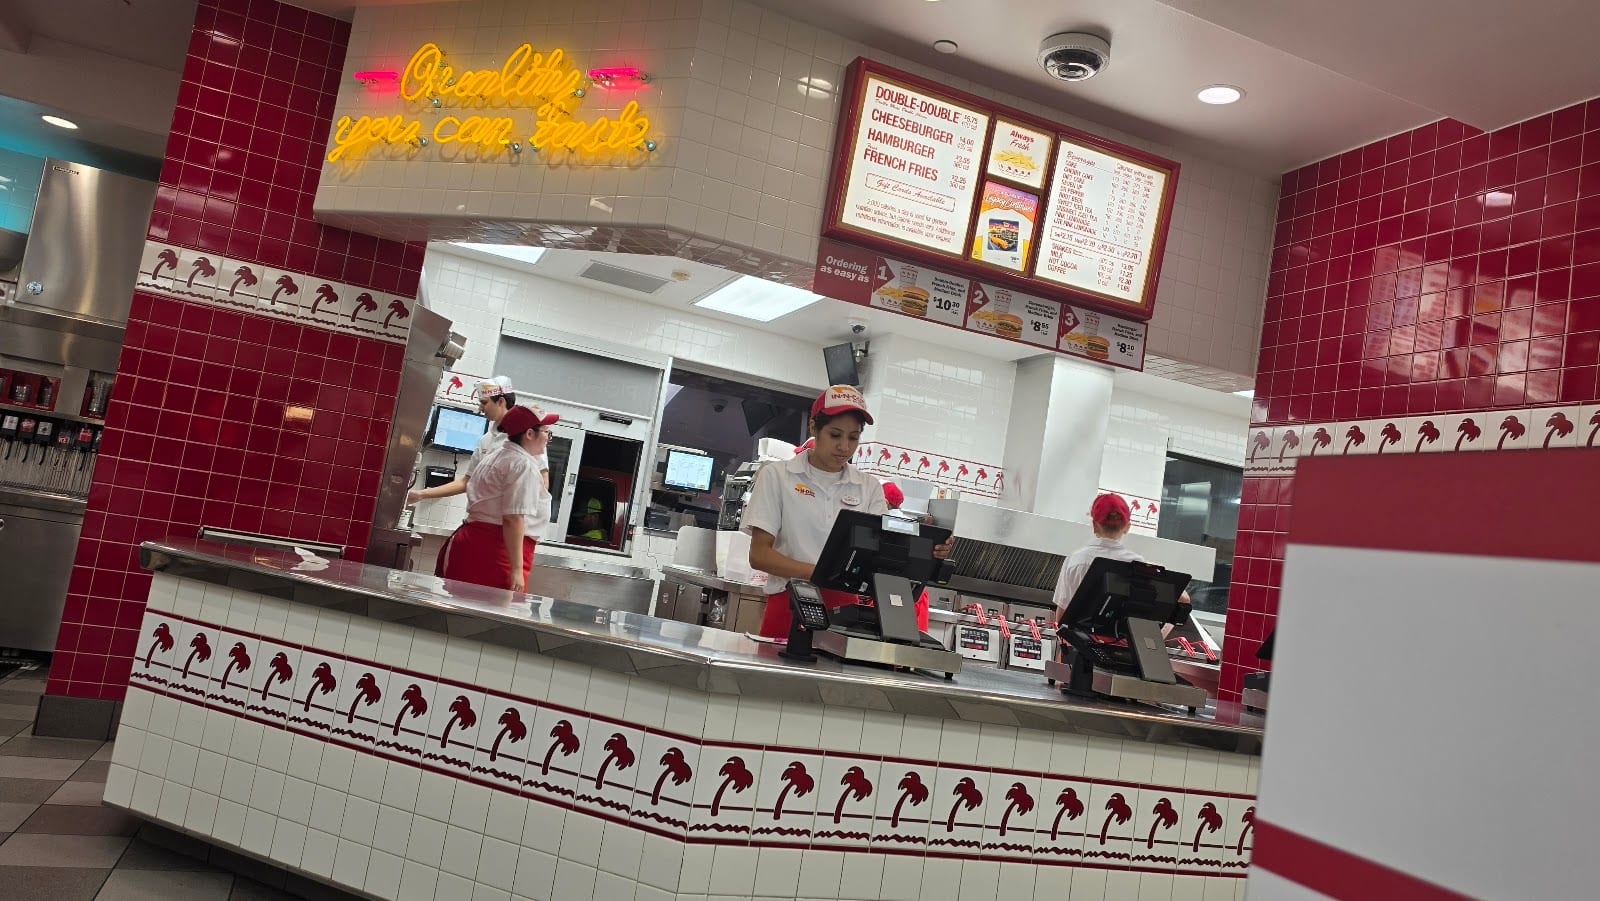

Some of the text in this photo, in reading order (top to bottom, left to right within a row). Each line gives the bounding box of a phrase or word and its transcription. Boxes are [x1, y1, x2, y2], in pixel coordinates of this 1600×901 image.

[400, 43, 581, 118] Quality
[327, 100, 650, 162] you can taste
[872, 109, 953, 145] CHEESEBURGER
[868, 128, 935, 159] HAMBURGER
[1010, 130, 1034, 143] Always
[1010, 139, 1030, 151] Fresh
[864, 148, 906, 171] FRENCH
[908, 162, 938, 182] FRIES
[876, 180, 945, 205] Gift Cards Available
[826, 256, 868, 274] Ordering
[877, 266, 887, 280] 1
[1047, 264, 1066, 275] COFFEE
[834, 269, 857, 280] easy
[858, 274, 870, 283] as
[973, 290, 984, 304] 2
[1064, 313, 1075, 326] 3
